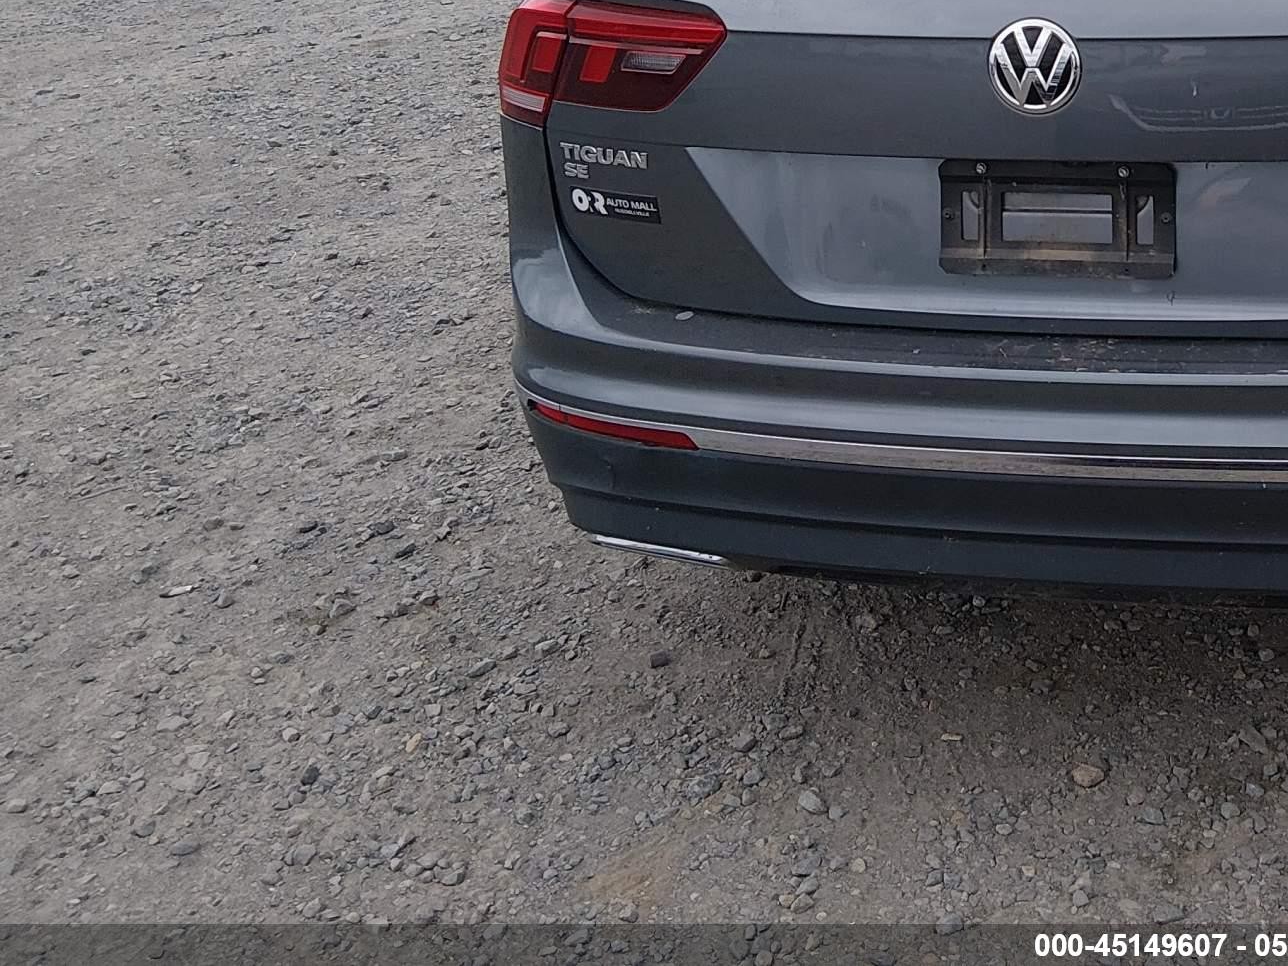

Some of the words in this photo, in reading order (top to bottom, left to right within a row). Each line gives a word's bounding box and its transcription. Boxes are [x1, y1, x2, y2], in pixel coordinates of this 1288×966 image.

[559, 141, 648, 170] TIGUAN
[563, 162, 590, 179] SE
[606, 197, 630, 208] AUTO
[630, 200, 657, 212] MALL
